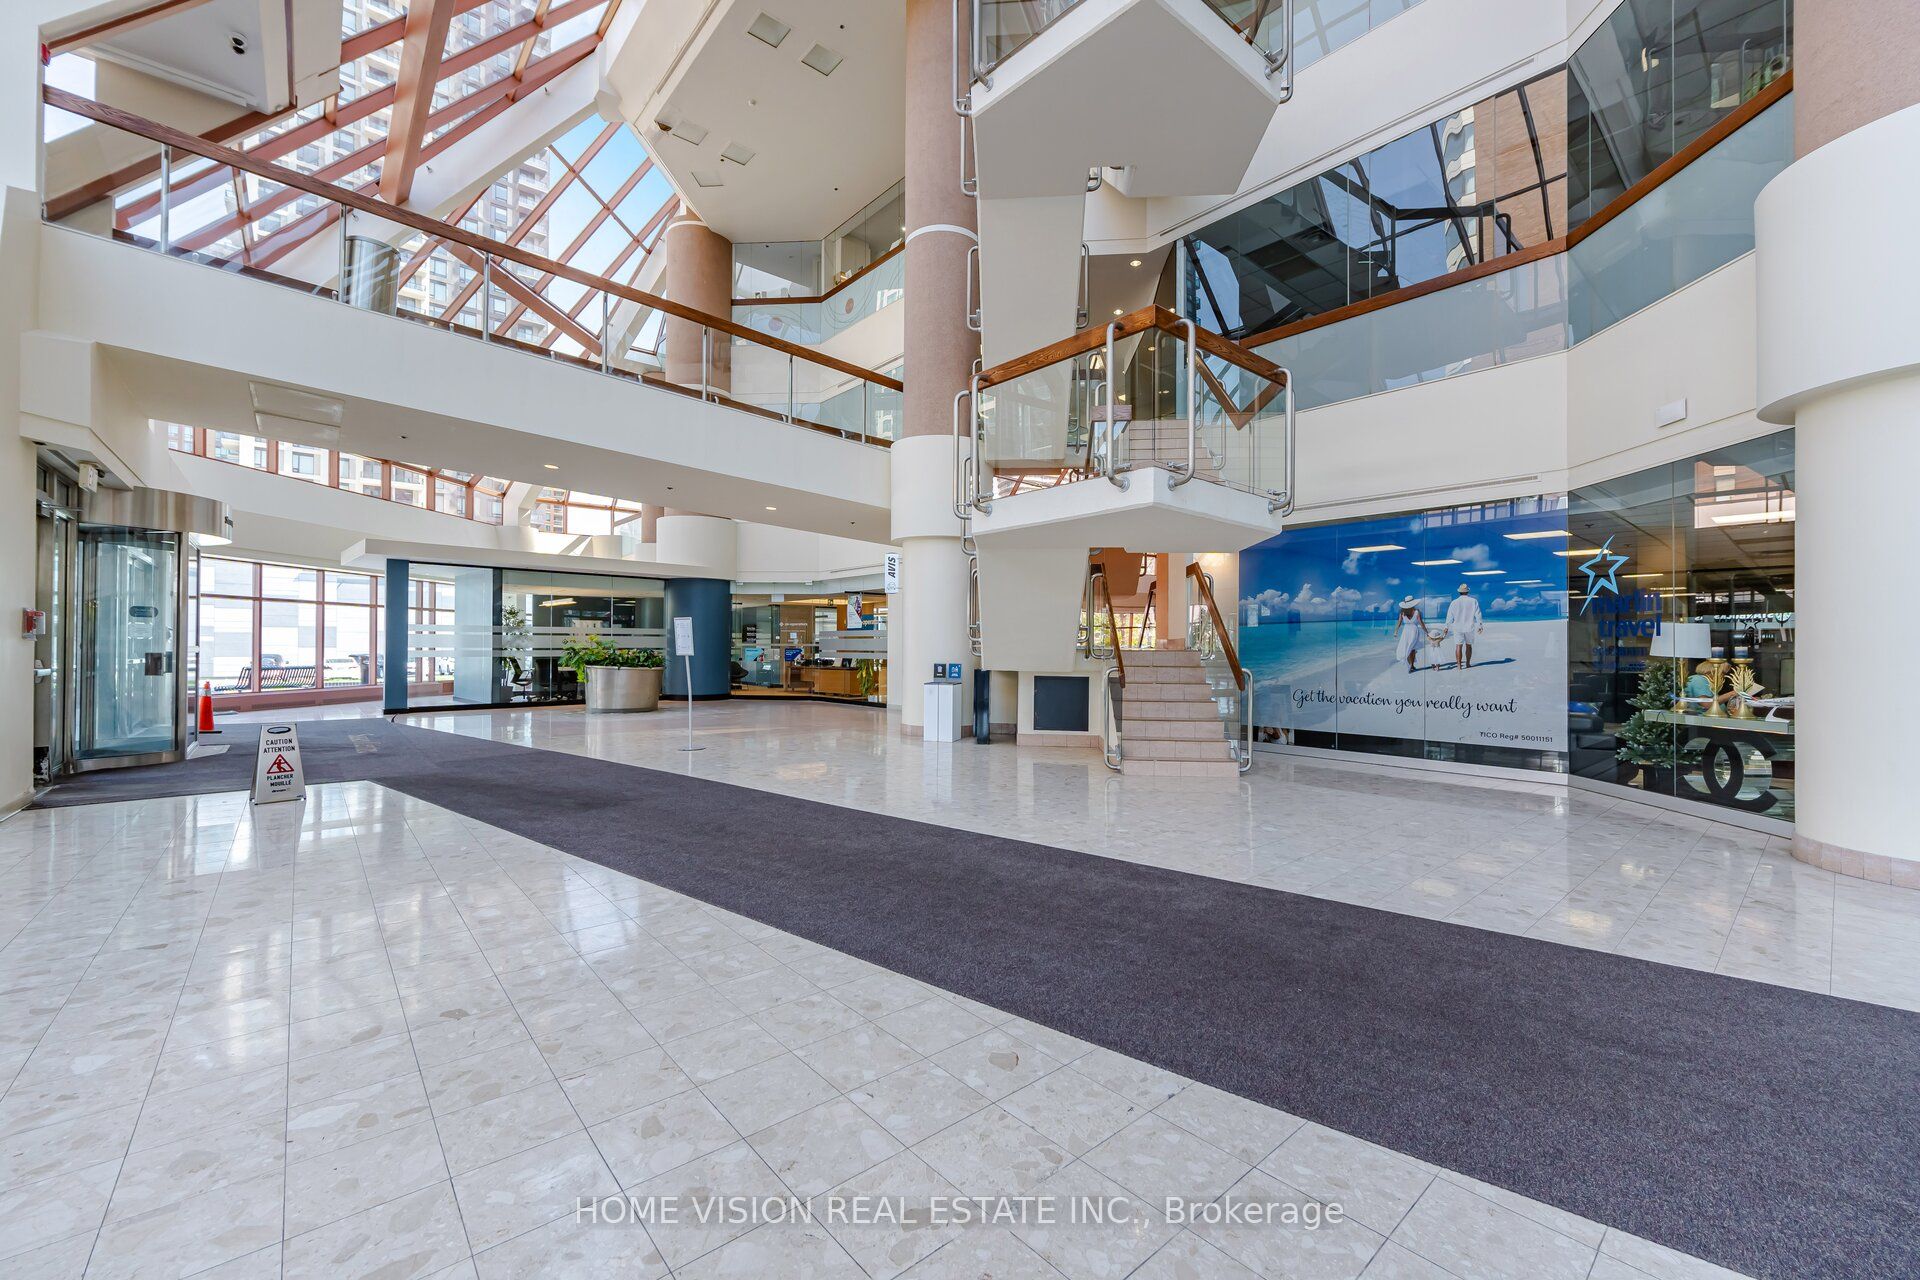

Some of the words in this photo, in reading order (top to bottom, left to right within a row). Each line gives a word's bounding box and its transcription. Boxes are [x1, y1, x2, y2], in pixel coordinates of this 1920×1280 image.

[888, 556, 896, 578] AVIS
[1599, 612, 1662, 638] travel
[1293, 689, 1314, 708] Get
[1317, 690, 1335, 703] the
[1339, 693, 1392, 706] vacation
[1395, 698, 1423, 714] you
[1426, 696, 1473, 718] really
[1477, 699, 1518, 713] want
[265, 738, 293, 746] CAUTION
[1480, 731, 1498, 739] TICO
[1521, 735, 1553, 743] 50011151
[263, 745, 296, 754] ATTENTION
